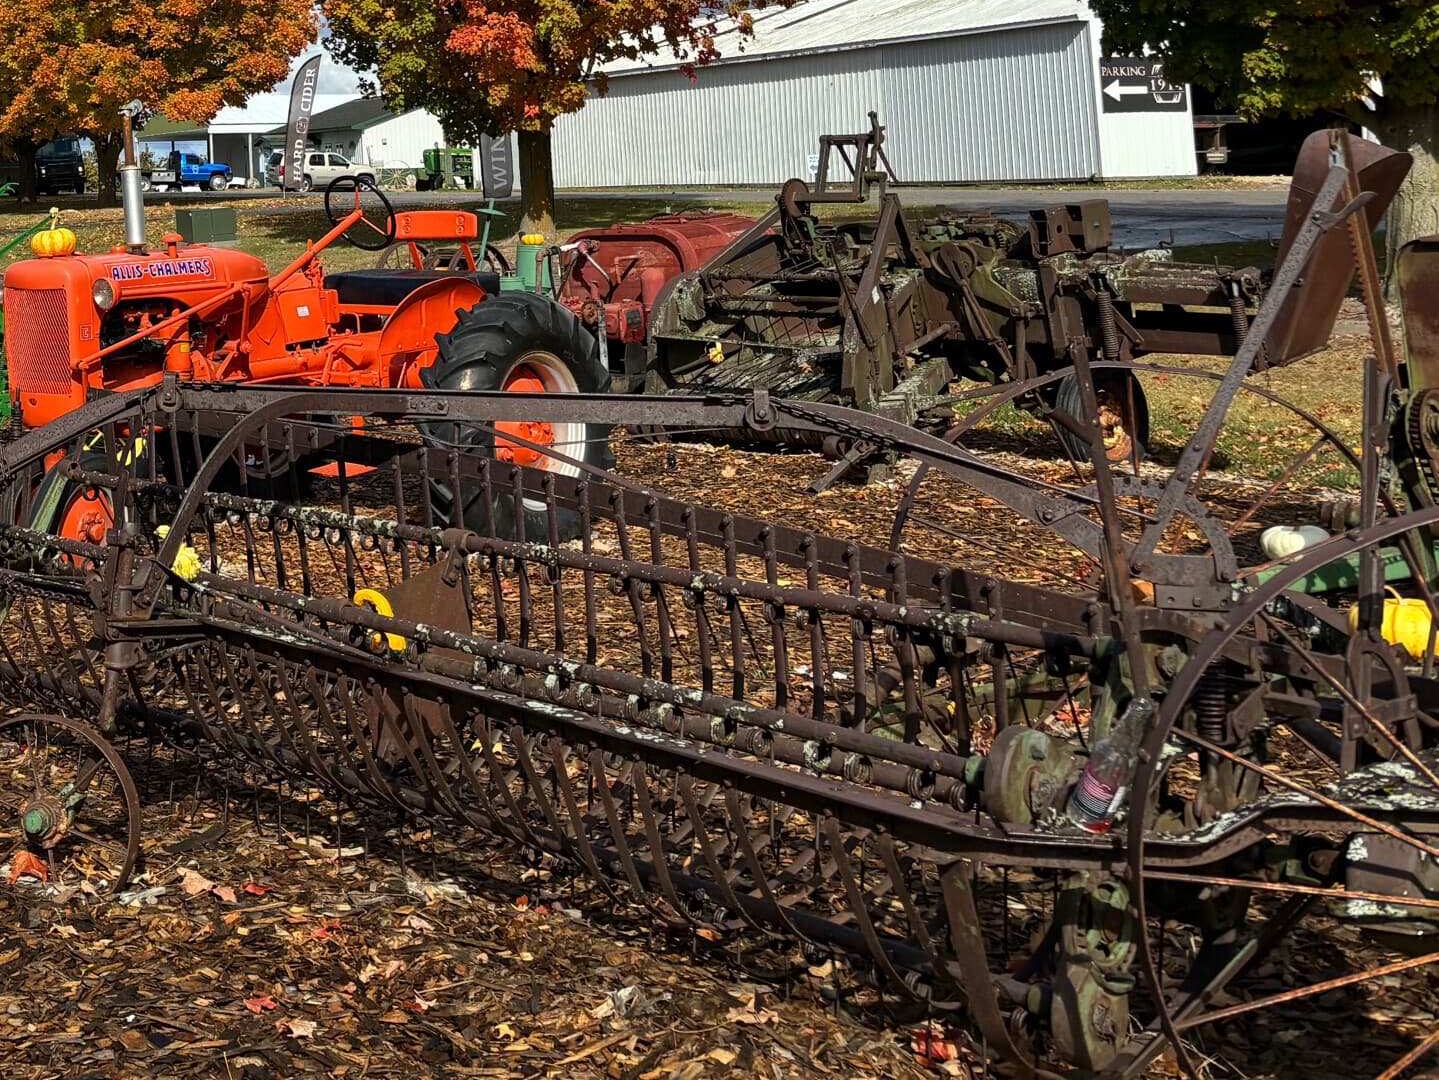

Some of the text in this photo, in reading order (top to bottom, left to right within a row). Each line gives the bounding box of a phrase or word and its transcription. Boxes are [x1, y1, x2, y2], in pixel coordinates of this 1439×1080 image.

[1101, 66, 1146, 76] PARKING
[293, 68, 316, 181] HARD CIDER
[112, 259, 211, 281] ALLIS-CHALMERS
